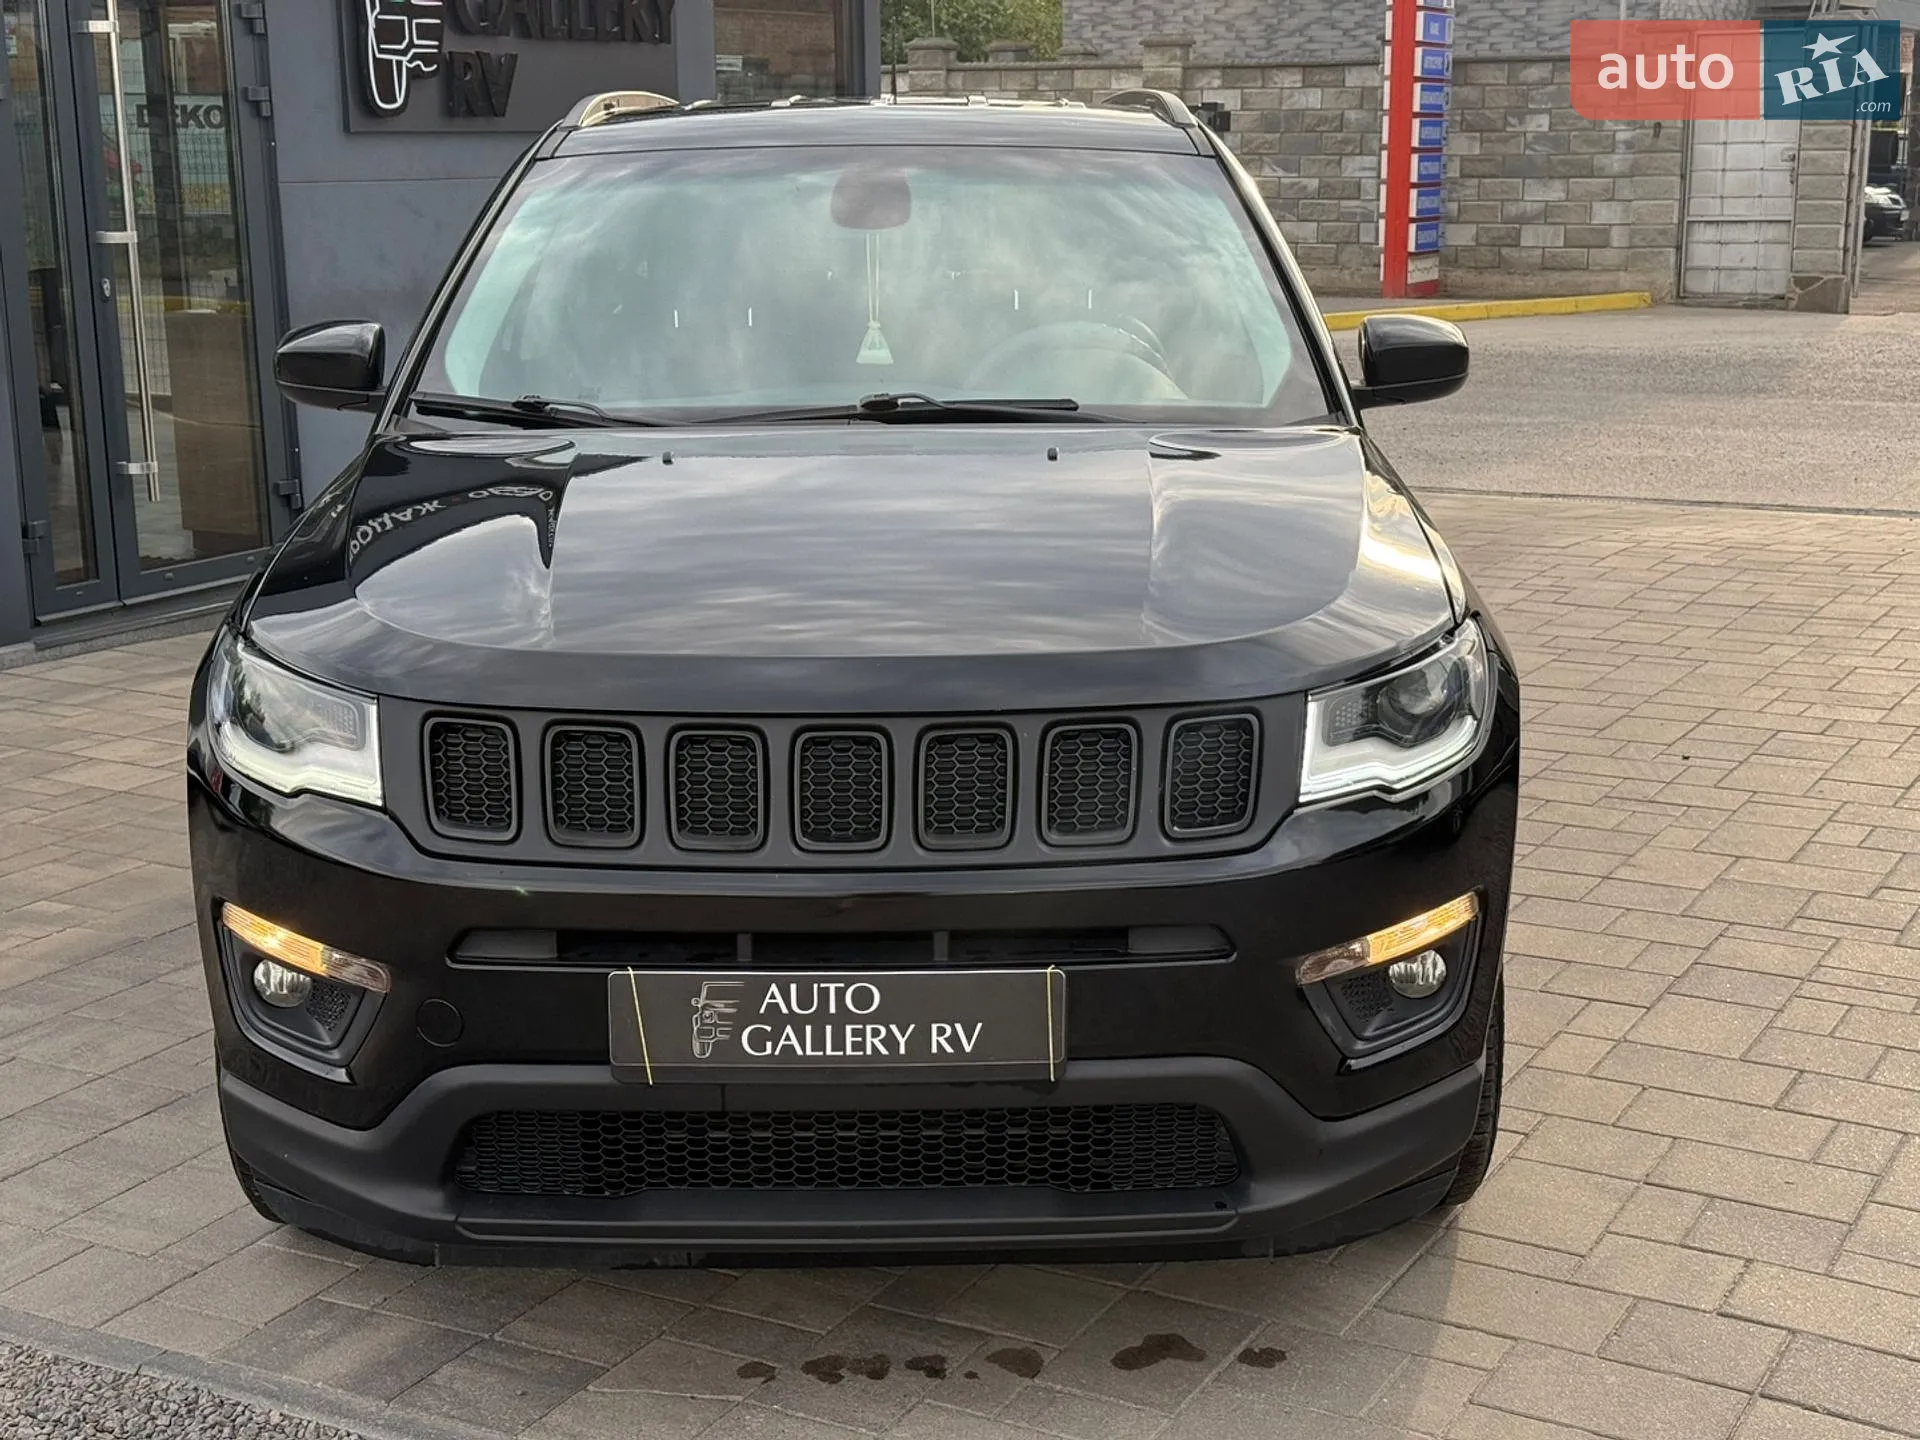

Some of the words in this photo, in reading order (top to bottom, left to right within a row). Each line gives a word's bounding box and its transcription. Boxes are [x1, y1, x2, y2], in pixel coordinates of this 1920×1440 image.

[447, 50, 518, 118] RV
[759, 982, 881, 1015] AUTO
[741, 1023, 916, 1056] GALLERY
[930, 1022, 983, 1054] RV
